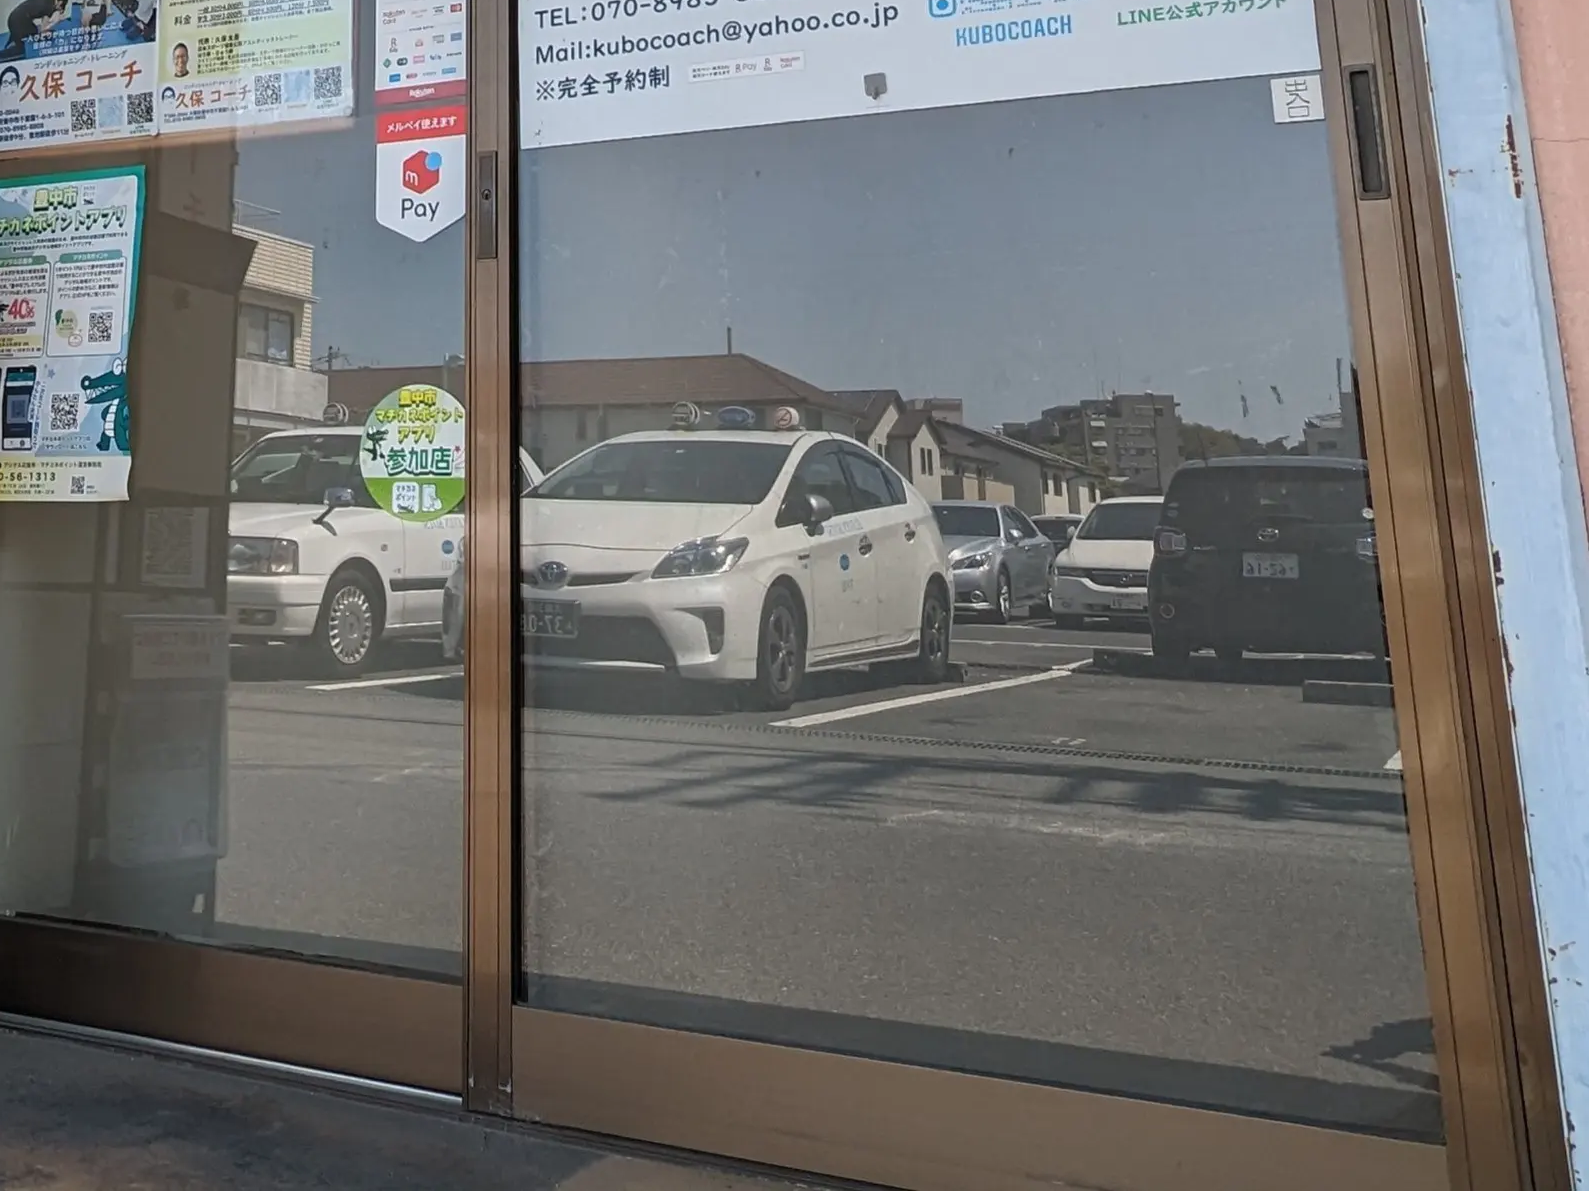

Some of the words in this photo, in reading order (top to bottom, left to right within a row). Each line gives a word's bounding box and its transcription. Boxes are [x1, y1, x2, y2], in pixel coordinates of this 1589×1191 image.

[535, 2, 900, 65] Mail:kubocoach@yahoo.co.jp
[955, 14, 1073, 47] KUBOCOACH
[19, 70, 67, 103] 久保
[75, 59, 143, 92] コーチ
[175, 88, 206, 110] 久保
[210, 84, 253, 104] コーチ
[386, 116, 457, 134] メルペイ使えます
[401, 198, 440, 222] Pay
[397, 424, 436, 444] アプリ
[386, 446, 453, 474] 参加店
